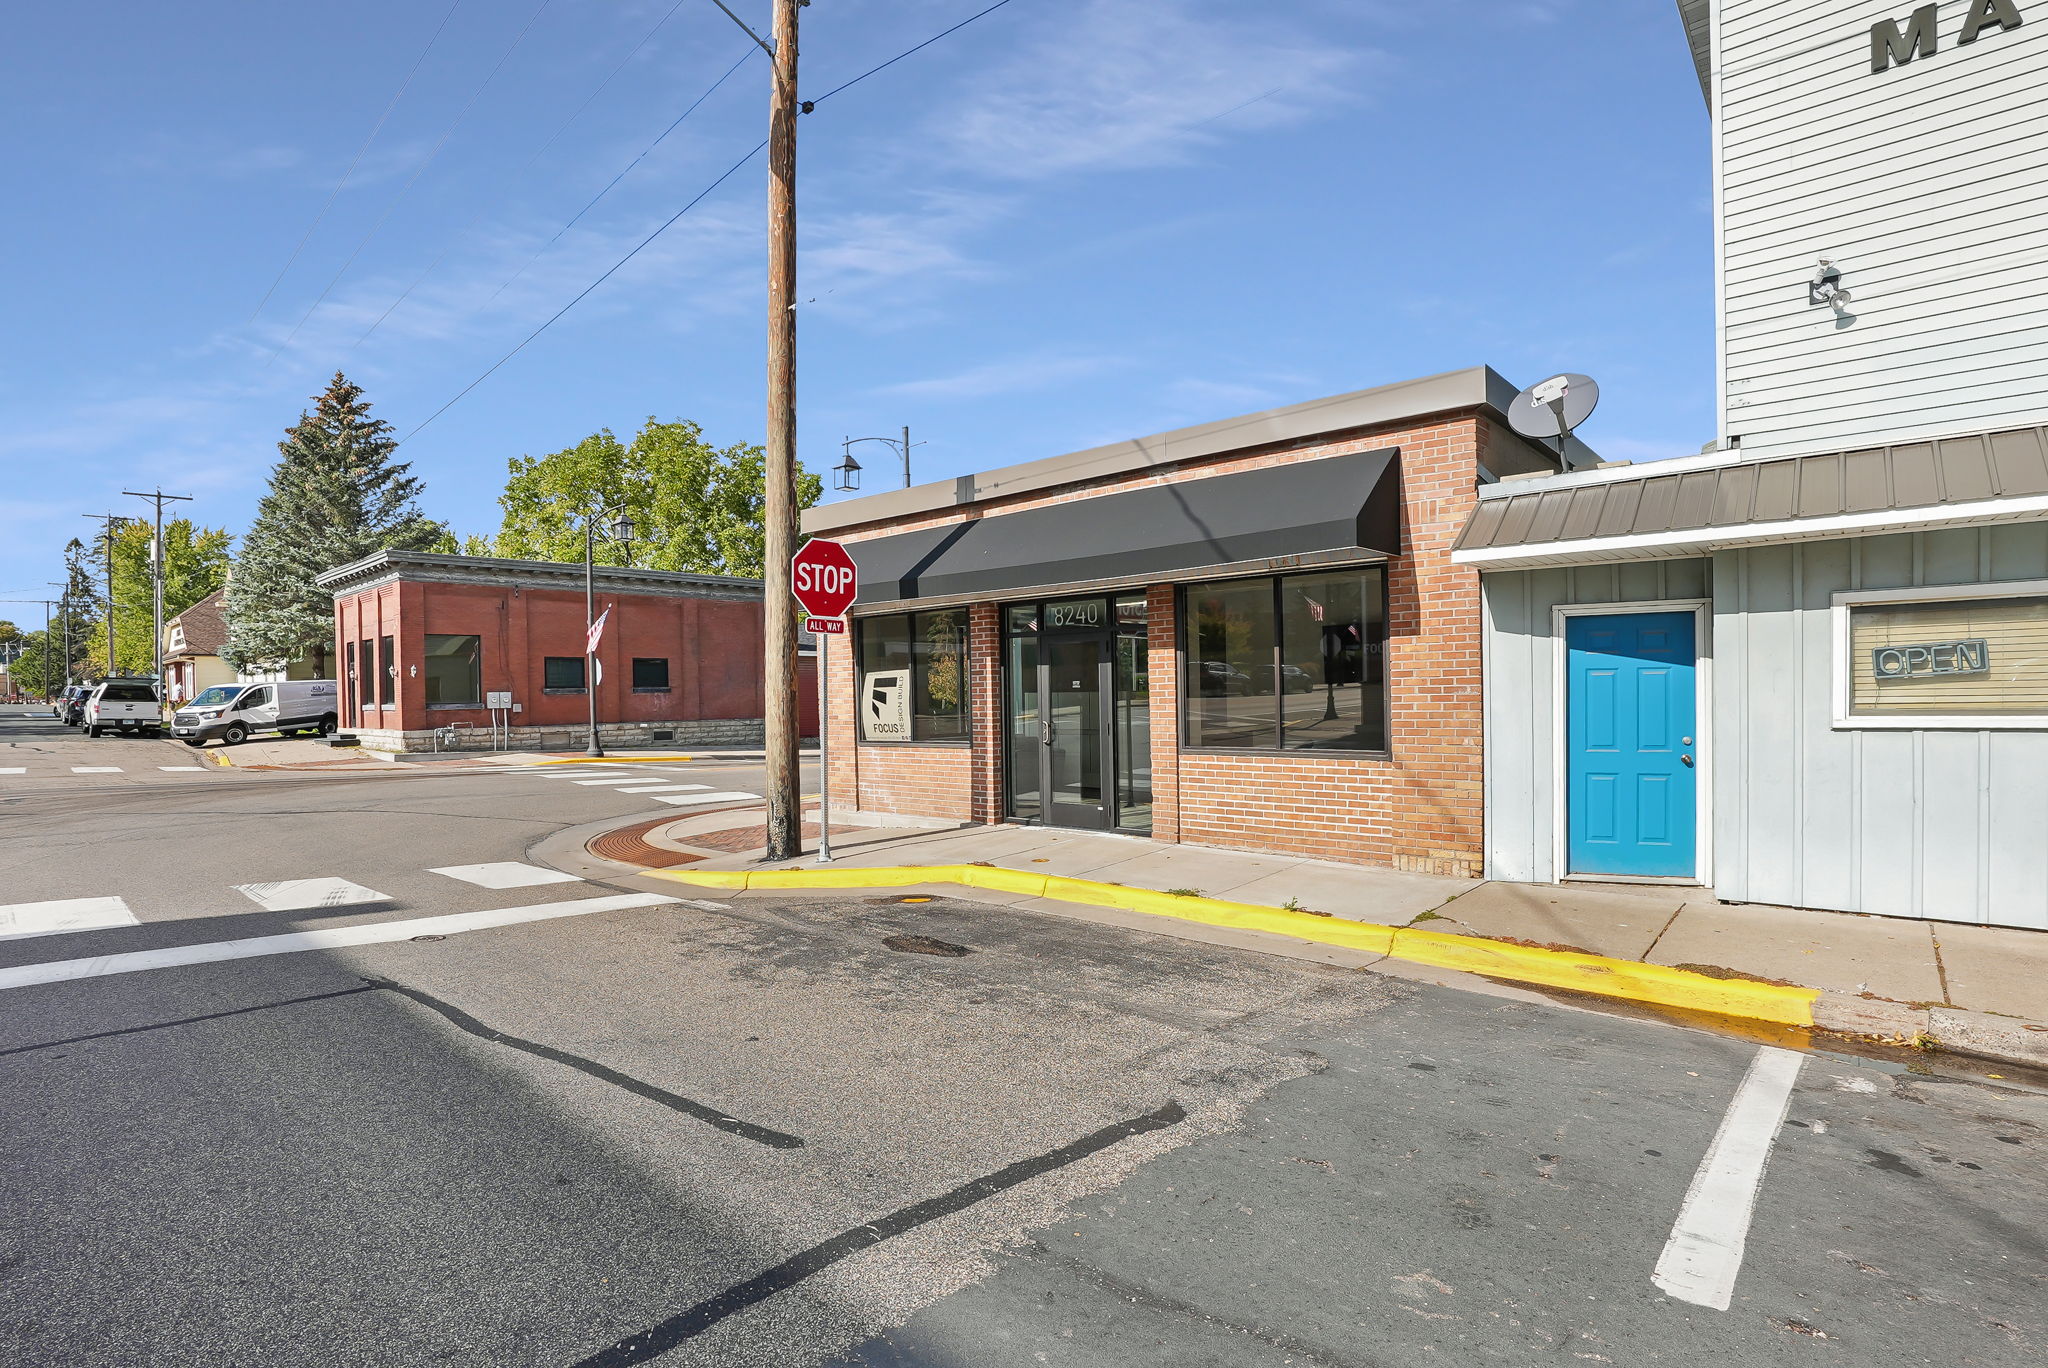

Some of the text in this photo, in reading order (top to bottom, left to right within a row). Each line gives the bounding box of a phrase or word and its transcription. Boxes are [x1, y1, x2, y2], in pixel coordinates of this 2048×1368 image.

[797, 562, 853, 595] STOP
[810, 621, 842, 632] ALL WAY
[1054, 603, 1098, 626] 8240
[1879, 643, 1982, 675] OPEN
[873, 723, 899, 734] FOCUS
[897, 701, 905, 733] DESIGN
